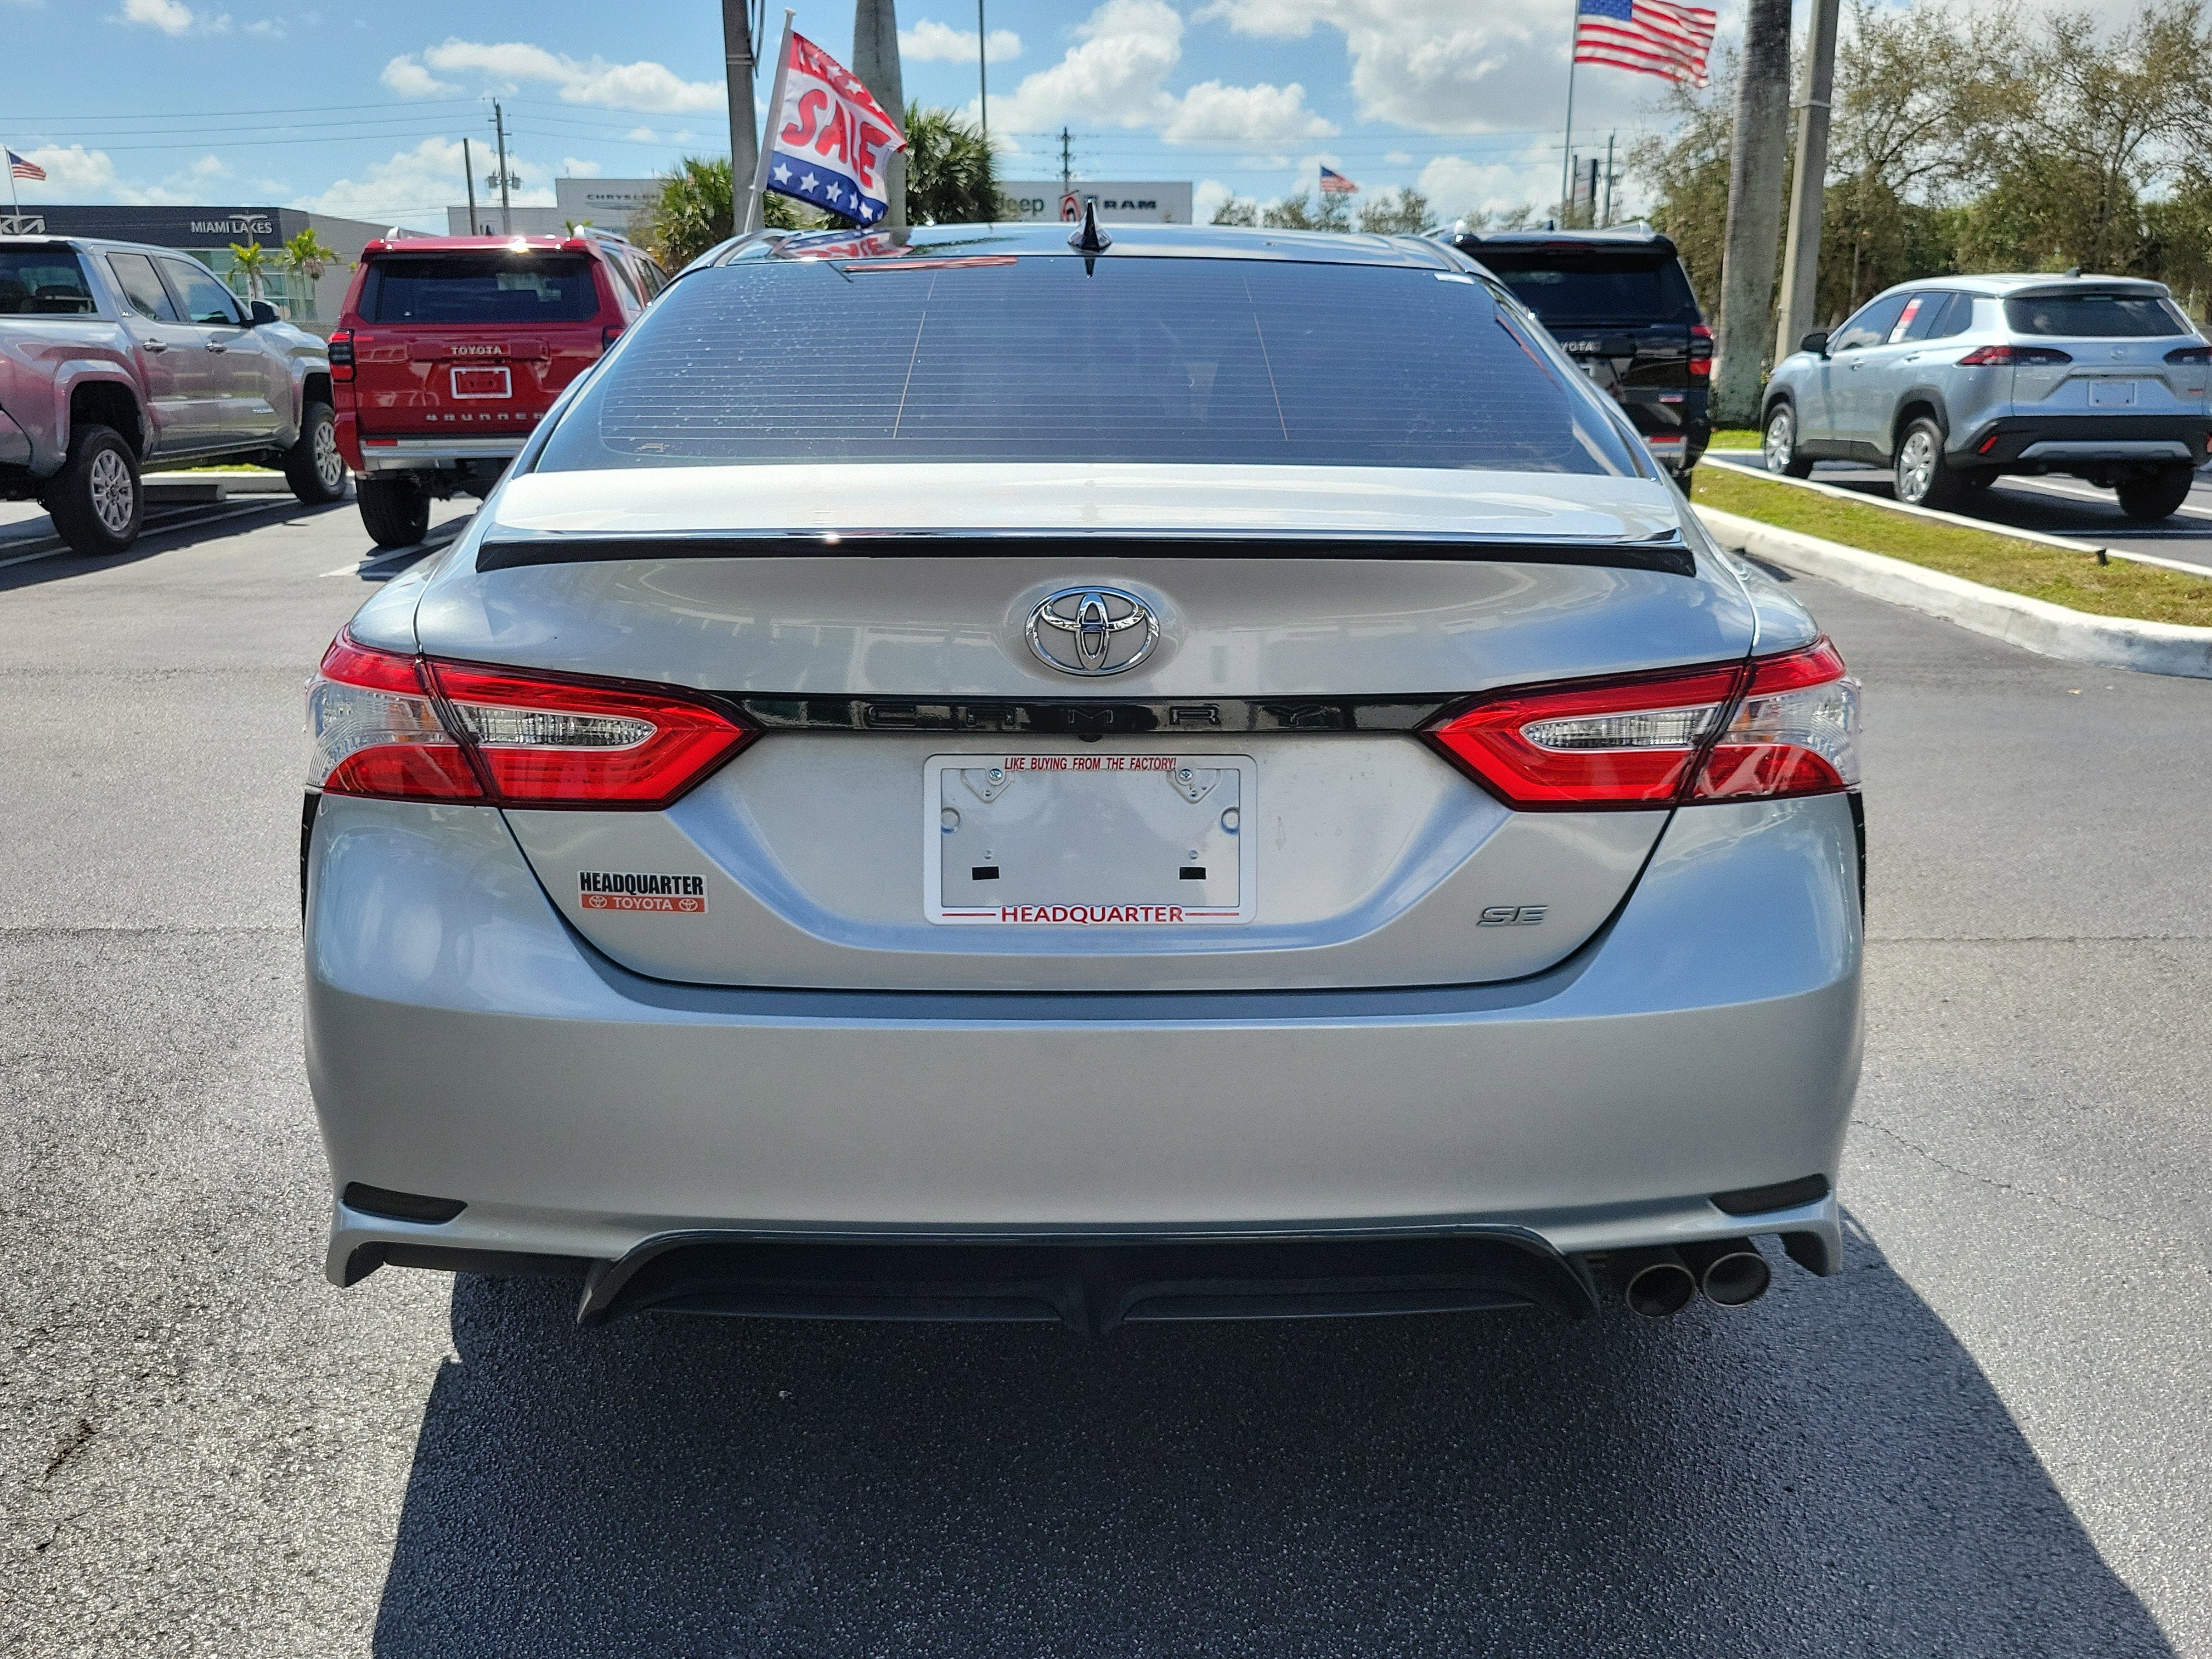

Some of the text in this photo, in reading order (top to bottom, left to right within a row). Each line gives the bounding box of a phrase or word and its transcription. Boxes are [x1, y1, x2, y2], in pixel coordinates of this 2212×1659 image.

[781, 89, 891, 189] SALE
[1104, 200, 1156, 210] RAM
[191, 221, 273, 234] MIAMI LAKES
[451, 346, 502, 355] TOYOTA
[1559, 341, 1593, 352] YOTA
[866, 703, 1333, 729] CAMRY
[1005, 757, 1176, 770] LIKE BUYING FROM THE FACTORY!
[580, 872, 703, 895] HEADQUARTER
[613, 896, 673, 910] TOYOTA
[1001, 907, 1184, 924] HEADQUARTER
[1476, 905, 1548, 926] SE
